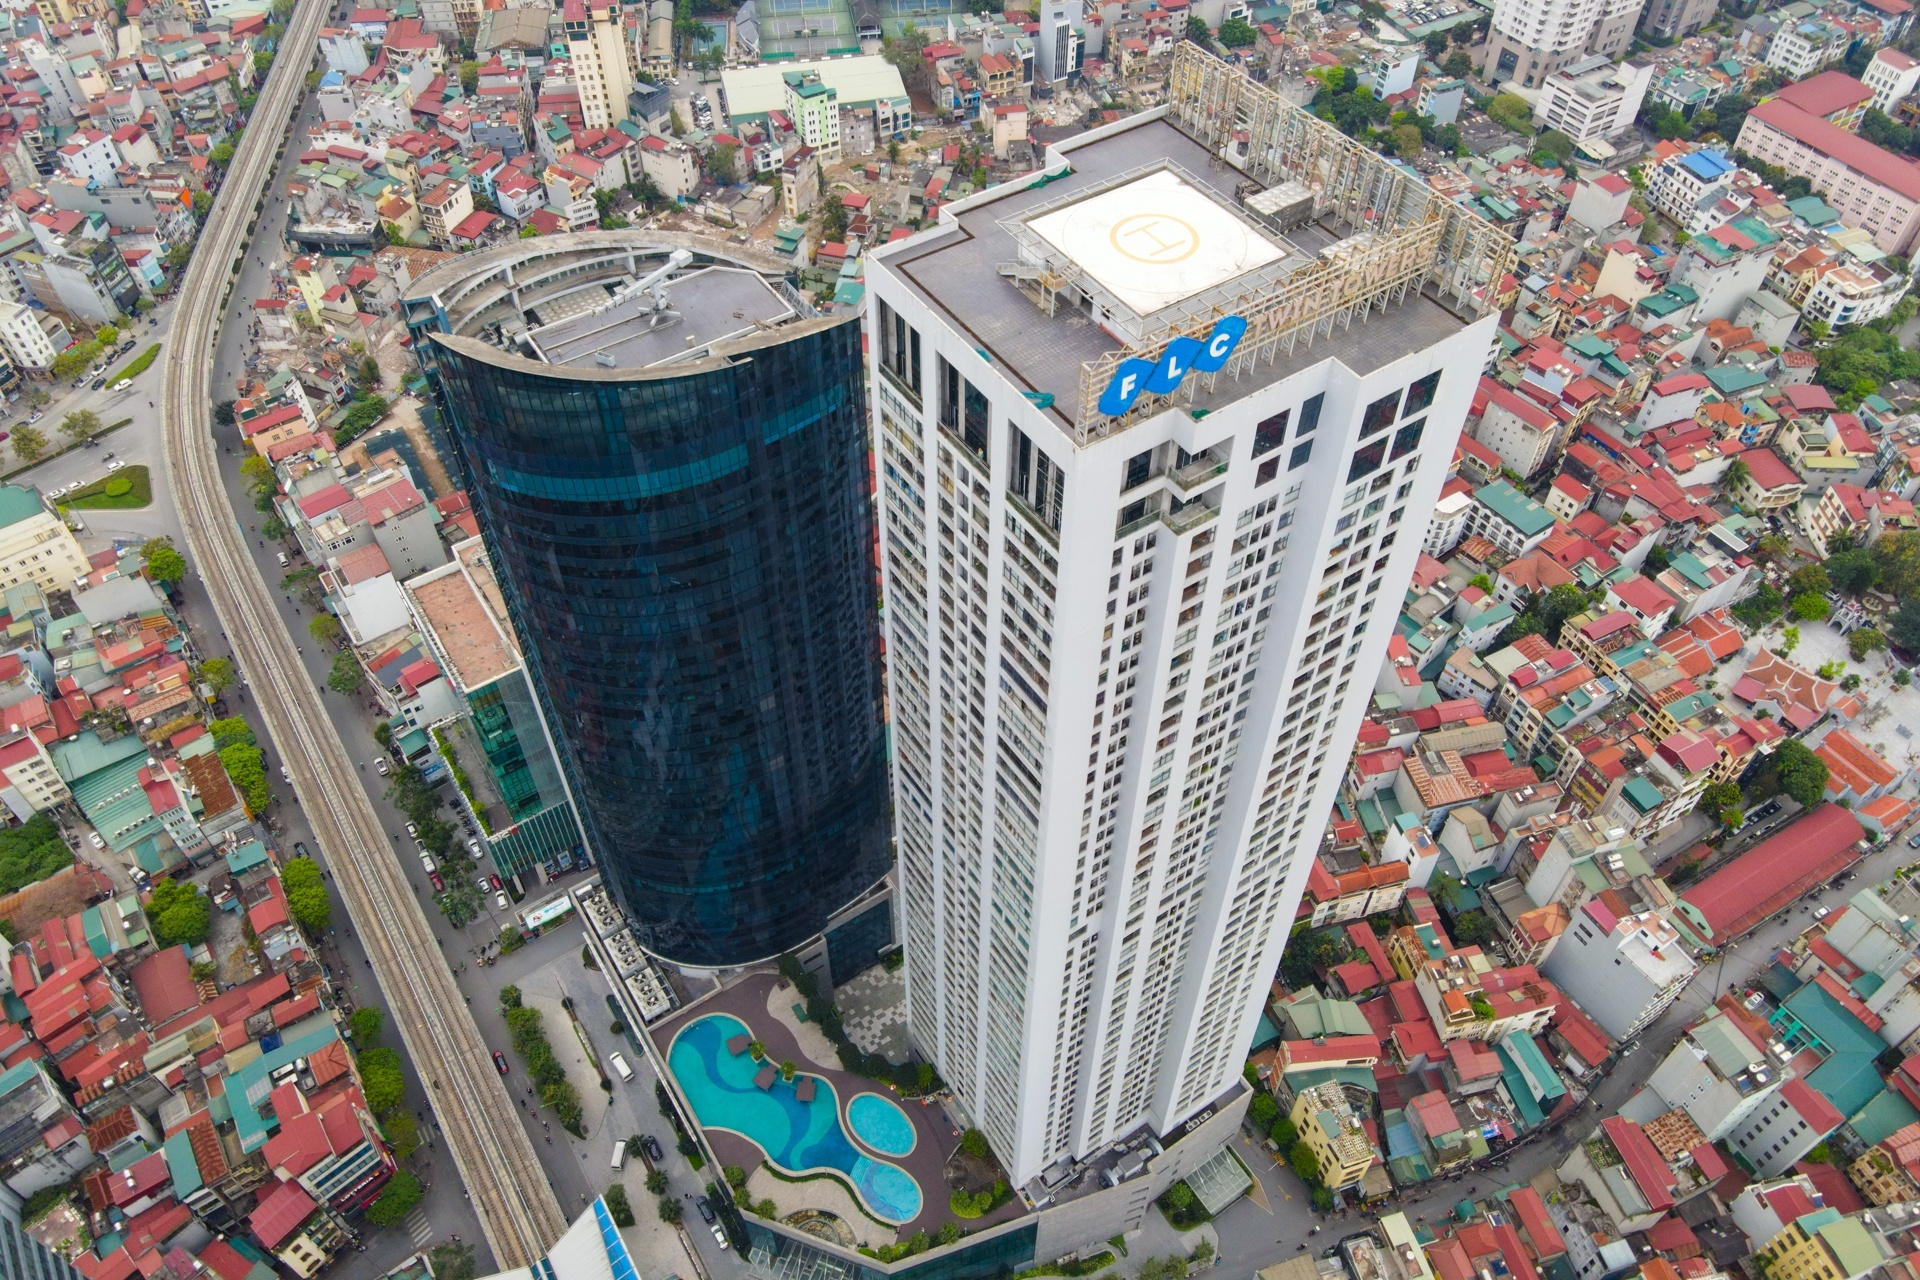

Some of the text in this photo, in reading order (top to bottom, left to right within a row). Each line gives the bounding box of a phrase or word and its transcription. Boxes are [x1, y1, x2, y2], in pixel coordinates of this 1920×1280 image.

[1124, 221, 1186, 257] H
[1120, 240, 1432, 400] FLC TWIN TOWERS
[341, 1177, 374, 1202] LOTTERIA
